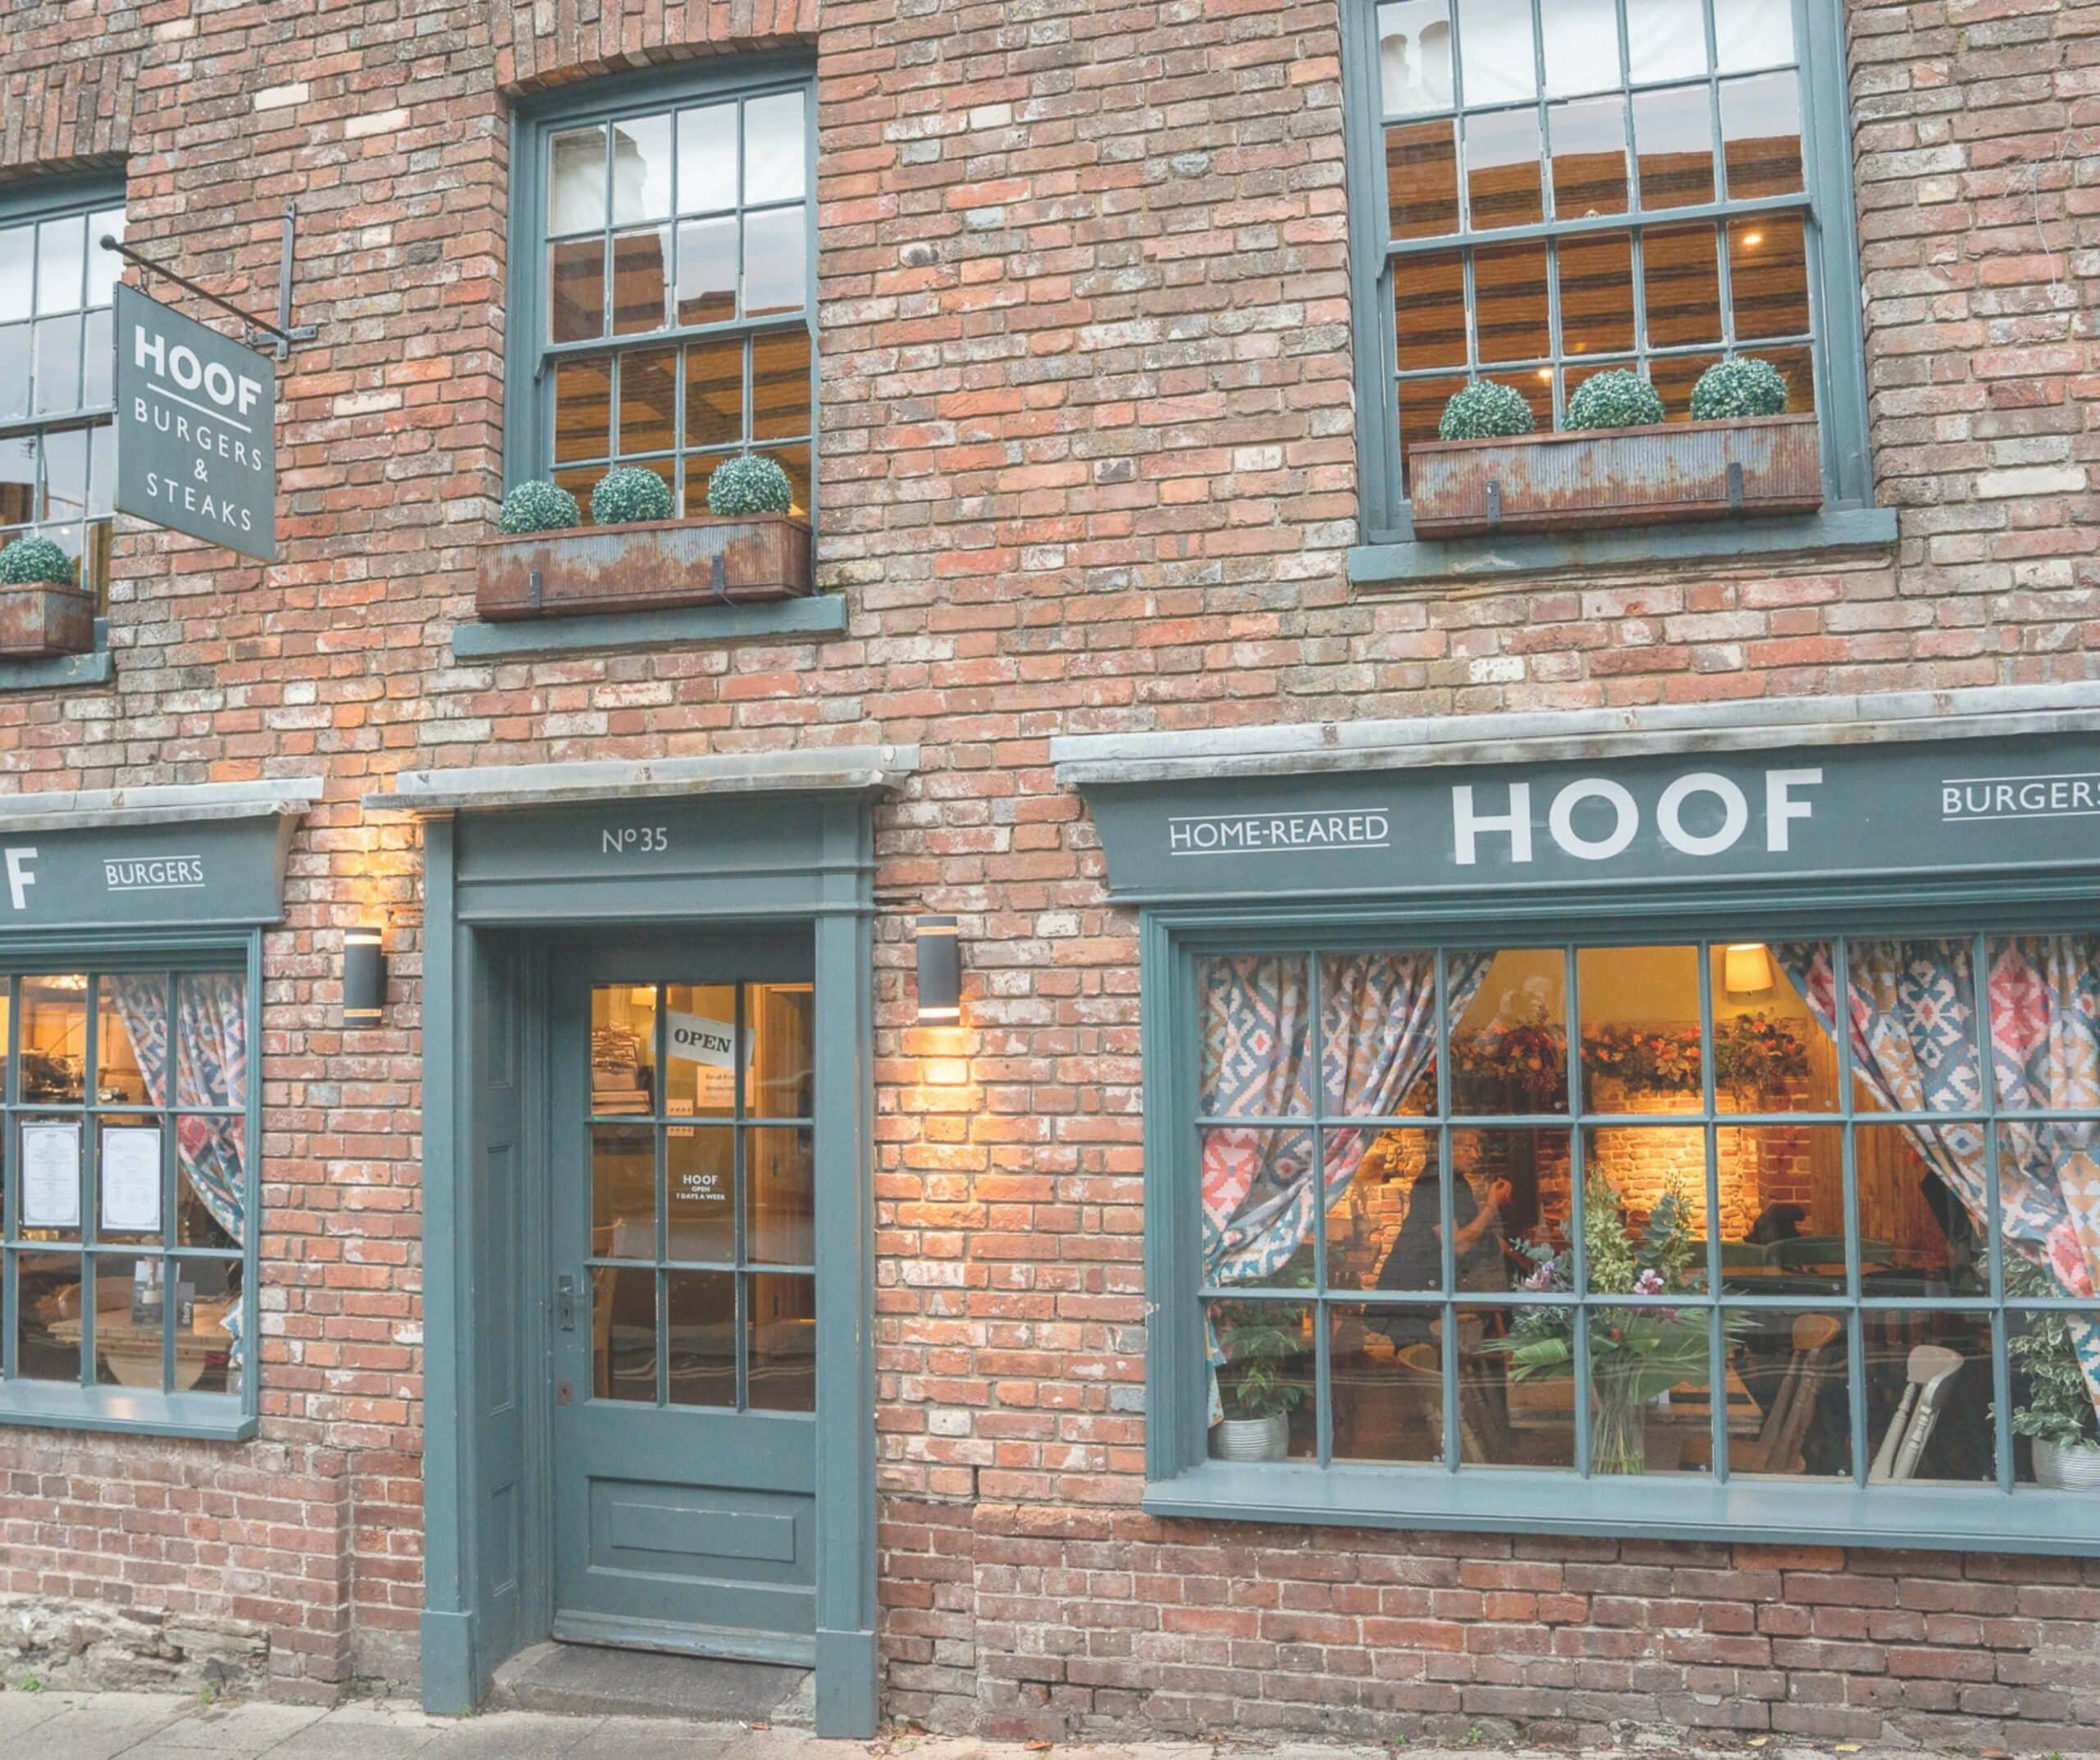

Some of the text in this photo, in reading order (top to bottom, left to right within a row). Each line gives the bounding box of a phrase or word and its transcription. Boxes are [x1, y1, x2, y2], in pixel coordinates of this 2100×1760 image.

[135, 324, 262, 415] HOOF
[135, 397, 262, 472] BURGERS
[194, 458, 208, 482] &
[146, 472, 251, 531] STEAKS
[1170, 768, 2100, 866] HOME-REARED HOOF BURGER
[105, 860, 204, 886] BURGERS
[673, 1028, 733, 1054] OPEN
[682, 1174, 719, 1186] HOOF
